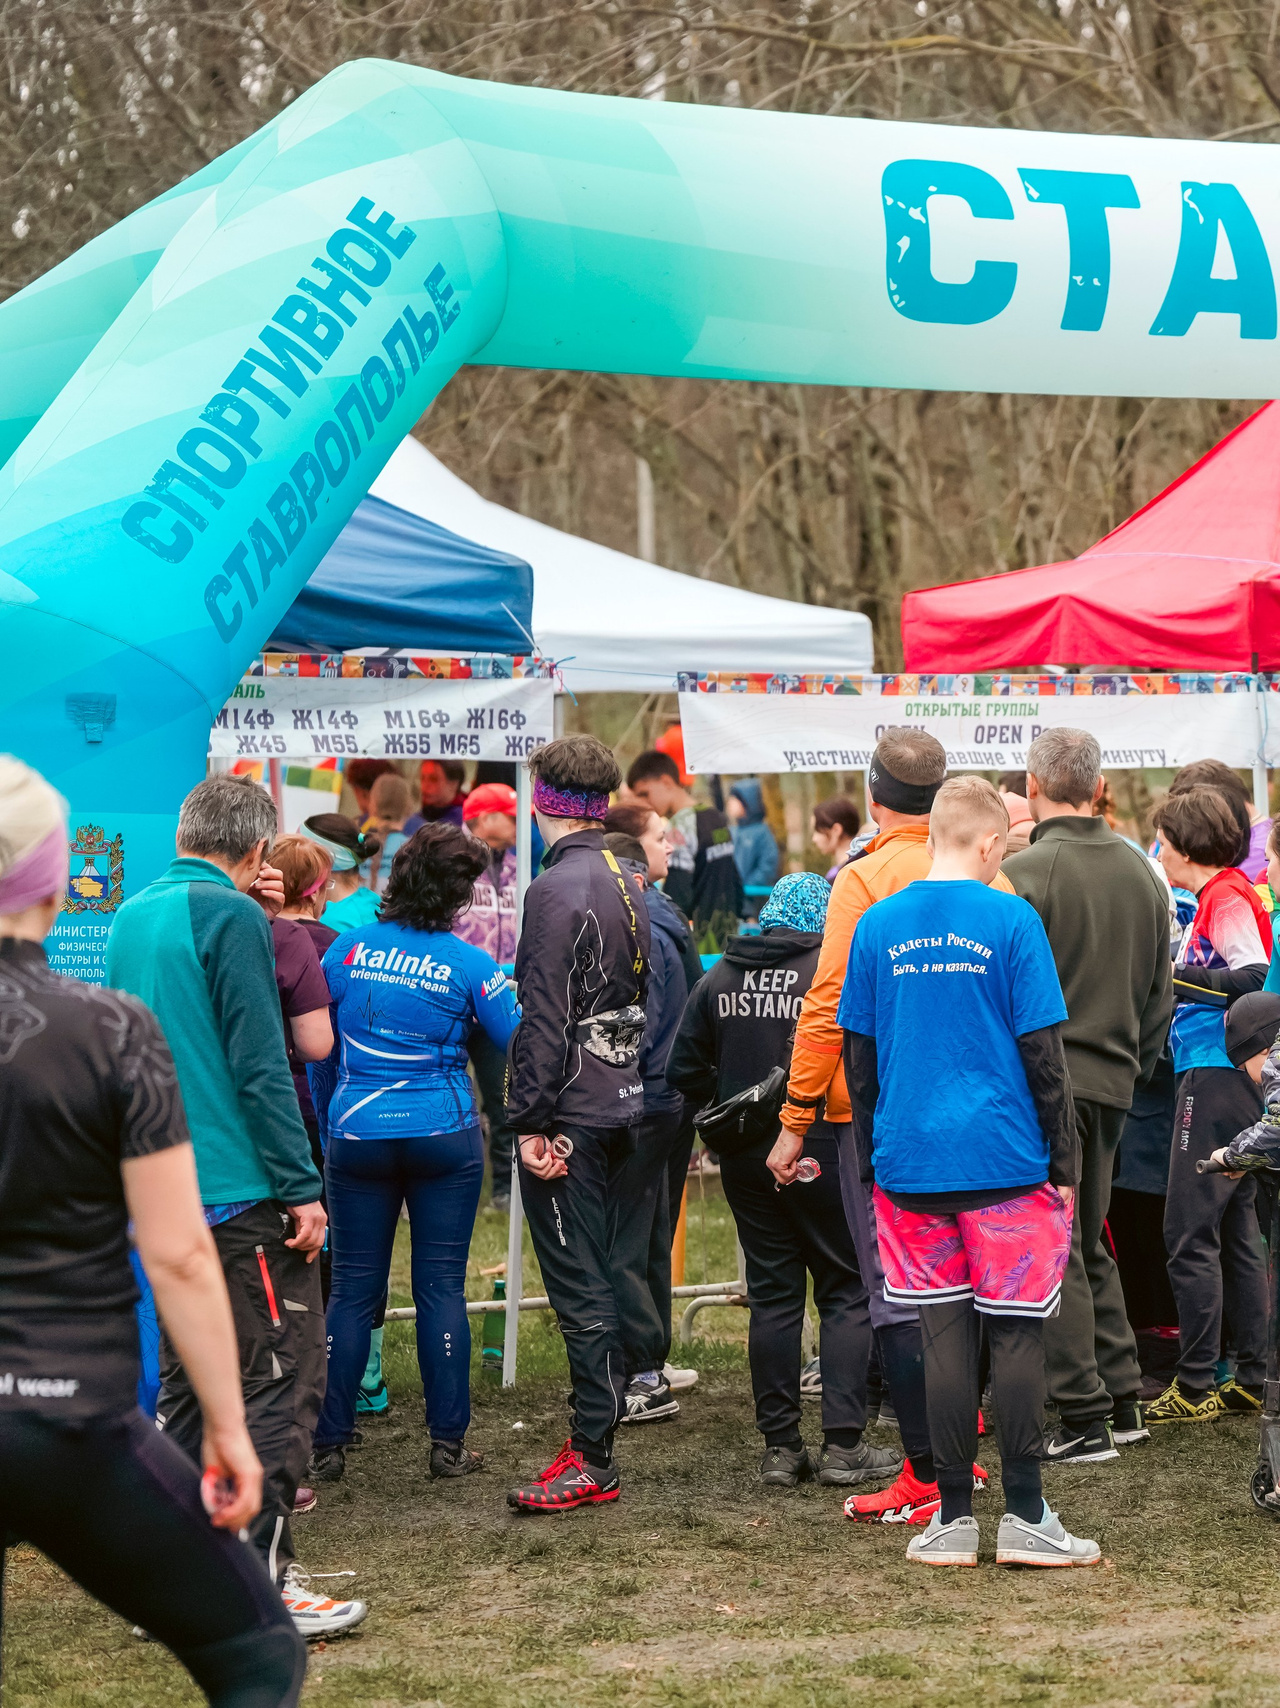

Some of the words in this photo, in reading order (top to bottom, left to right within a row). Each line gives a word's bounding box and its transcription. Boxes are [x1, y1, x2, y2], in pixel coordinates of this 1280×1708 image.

[120, 196, 417, 564] СПОРТИВНОЕ
[203, 262, 462, 645] СТАВРОПОЛЬЕ
[228, 683, 266, 699] АЛЬ
[291, 708, 359, 731] Ж14Ф
[383, 709, 451, 729] М16Ф
[466, 707, 527, 731] Ж16Ф
[904, 702, 981, 718] ОТКРЫТЫЕ
[985, 701, 1040, 718] ГРУППЫ
[235, 734, 287, 754] Ж45
[311, 733, 359, 754] М55
[382, 733, 431, 755] Ж55
[439, 733, 481, 756] М65
[974, 724, 1023, 745] OPEN
[887, 936, 943, 961] Кадеты
[946, 932, 993, 960] России
[48, 955, 91, 965] УЛЬТУРЫ
[352, 941, 452, 982] kalinka
[893, 963, 919, 977] Быть,
[922, 963, 929, 973] а
[931, 963, 944, 973] не
[945, 962, 988, 975] казаться.
[350, 967, 419, 990] orienteering
[420, 978, 450, 995] team
[743, 968, 799, 993] KEEP
[618, 1086, 630, 1100] St.
[1182, 1096, 1194, 1129] FREDDY
[16, 1377, 80, 1398] wear
[958, 1519, 973, 1527] NIKE
